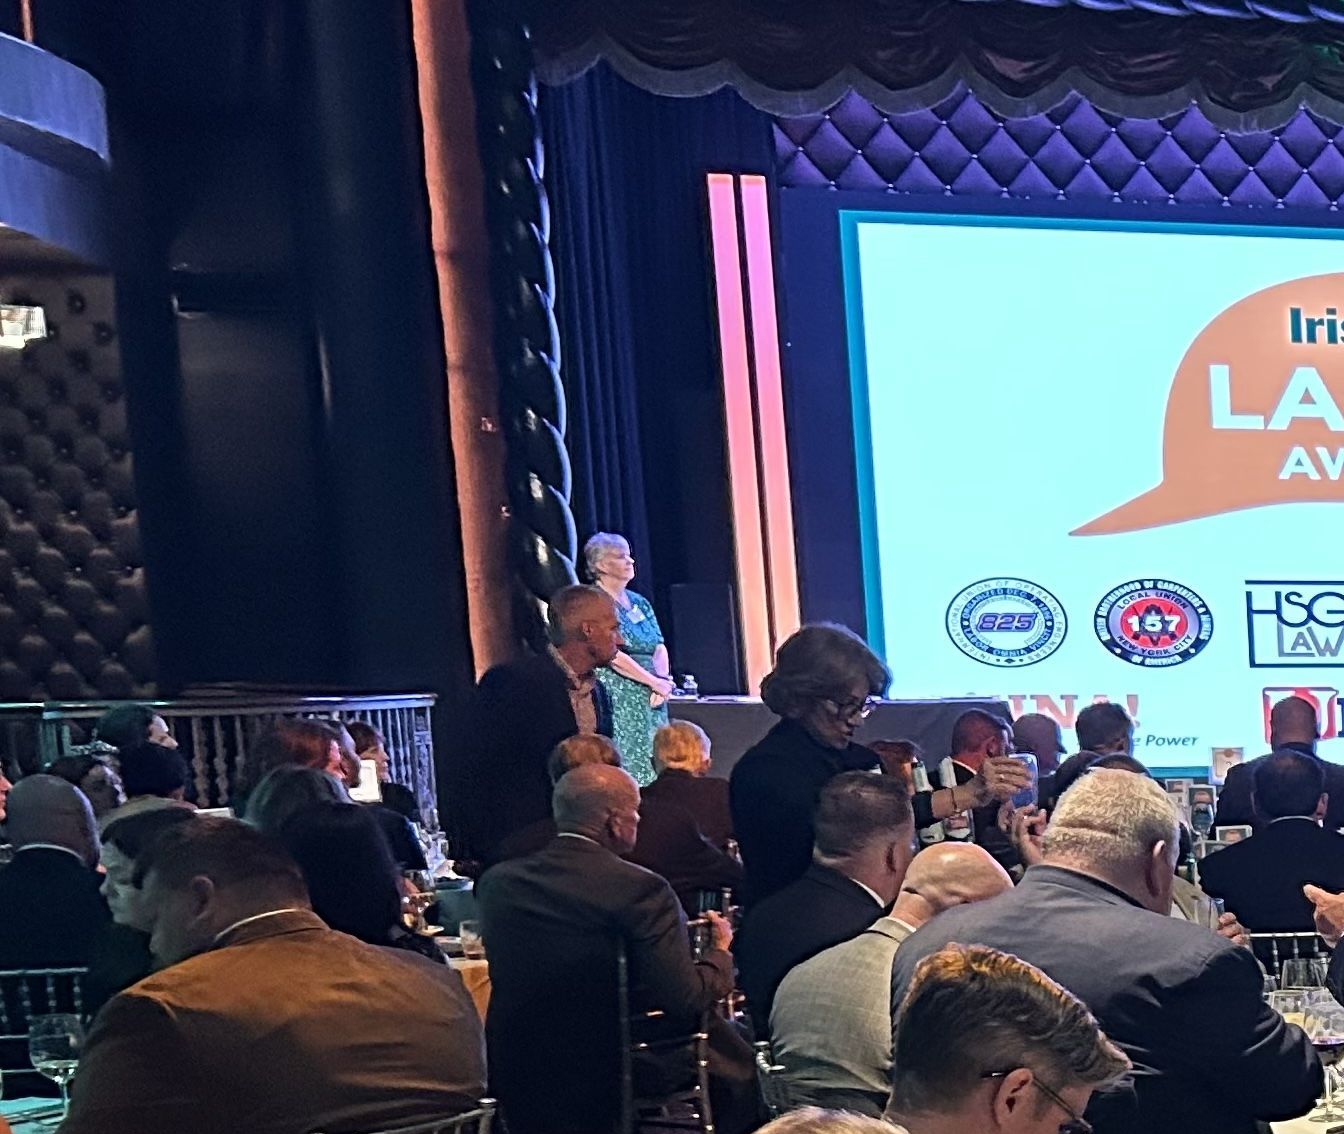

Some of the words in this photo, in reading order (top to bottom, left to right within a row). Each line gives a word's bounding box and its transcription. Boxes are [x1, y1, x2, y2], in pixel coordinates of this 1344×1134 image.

[1117, 591, 1151, 610] LOCAL
[1155, 591, 1189, 610] UNION
[977, 612, 1038, 632] 825
[1127, 615, 1181, 632] 157
[1117, 634, 1137, 651] NEW
[1141, 648, 1171, 656] YORK
[1173, 634, 1194, 651] CITY
[1146, 734, 1200, 747] Power
